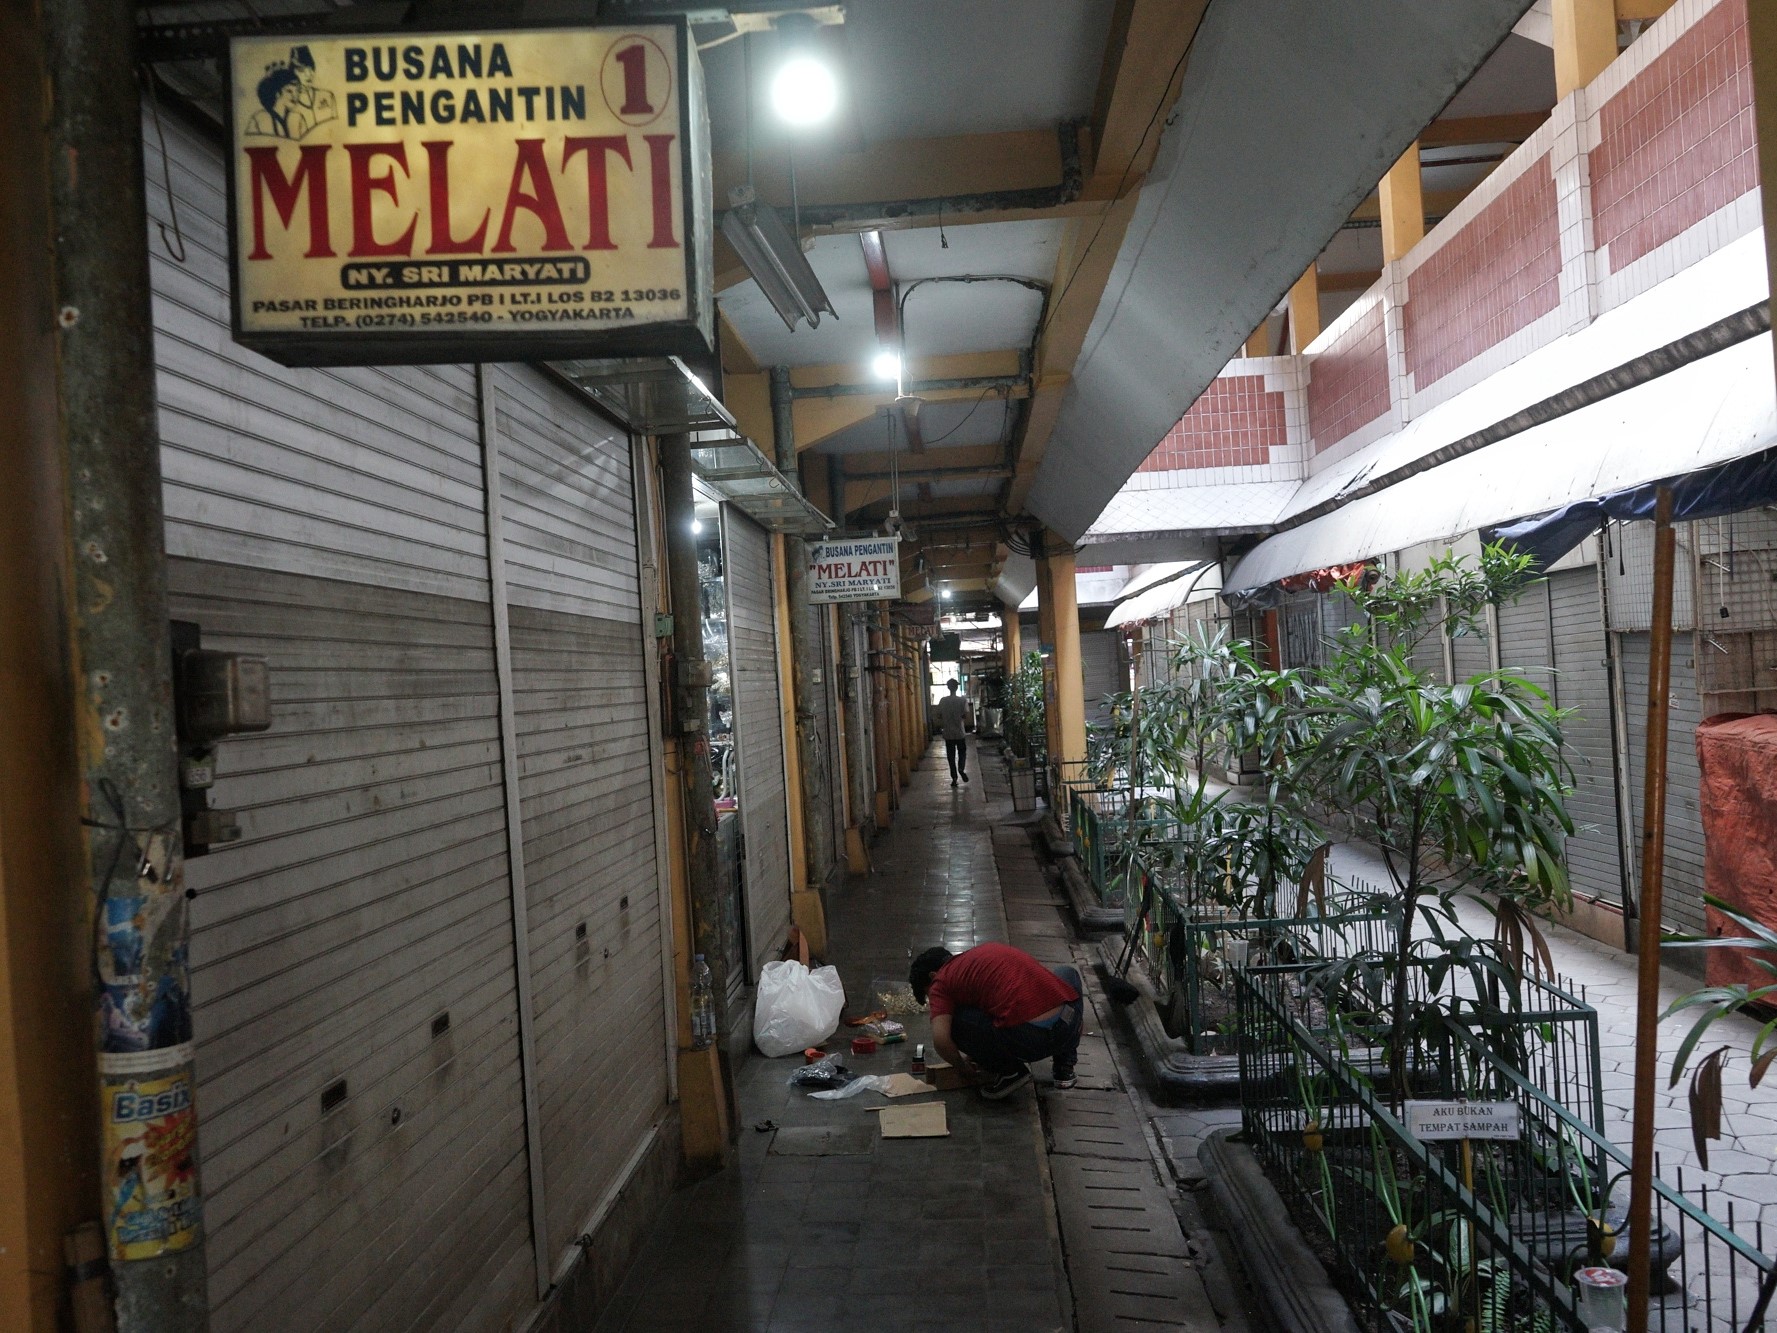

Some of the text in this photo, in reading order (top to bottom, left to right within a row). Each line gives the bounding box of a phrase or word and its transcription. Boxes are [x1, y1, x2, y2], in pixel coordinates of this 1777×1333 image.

[344, 43, 513, 82] BUSANA
[615, 44, 656, 115] 1
[347, 85, 587, 127] PENGANTIN
[243, 134, 681, 261] MELATI
[350, 262, 585, 285] NY. SRI MARYATI
[252, 300, 318, 313] PASAR
[324, 294, 462, 311] BERINGHARJO
[467, 293, 493, 306] PB
[547, 290, 585, 304] LOS
[590, 289, 616, 304] B2
[621, 288, 681, 302] 13036
[301, 317, 350, 329] TELP.
[355, 312, 415, 328] (0274)
[420, 310, 492, 325] 542540
[508, 307, 635, 322] YOGYAKARTA
[825, 542, 894, 558] BUSANA PENGANTIN
[809, 559, 895, 580] "MELATI"
[848, 578, 891, 587] MARYATI
[1433, 1106, 1494, 1117] AKU BUKAN
[1419, 1122, 1508, 1132] TEMPAT SAMPAH
